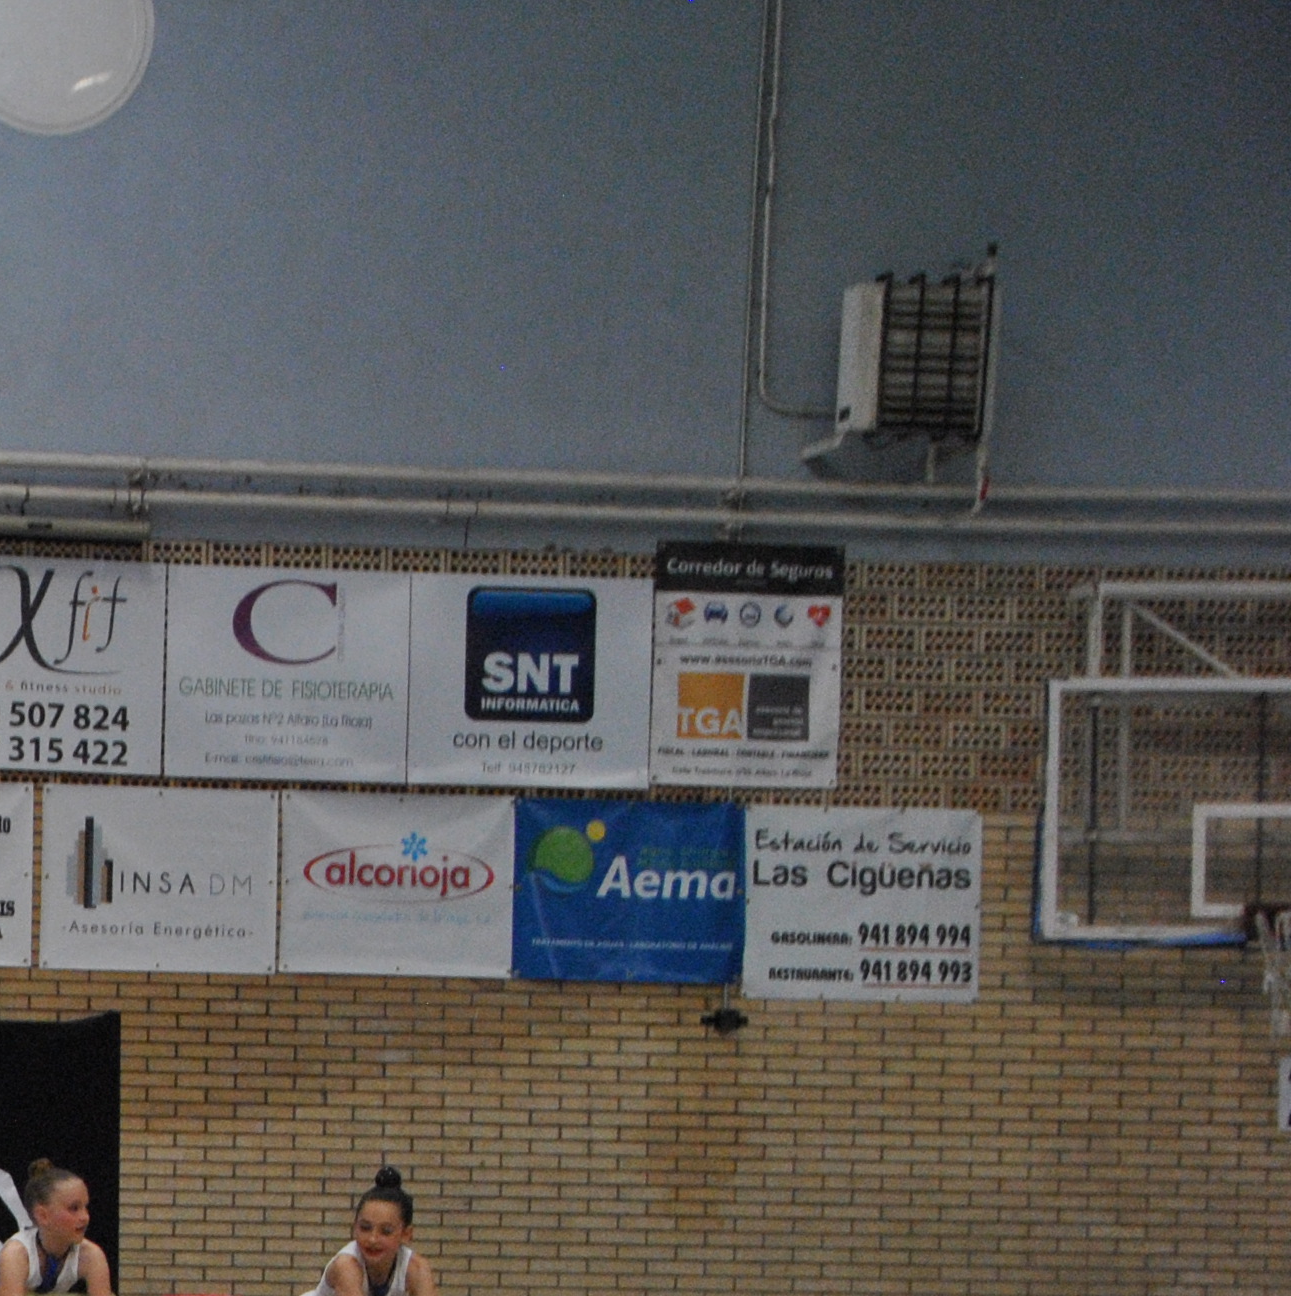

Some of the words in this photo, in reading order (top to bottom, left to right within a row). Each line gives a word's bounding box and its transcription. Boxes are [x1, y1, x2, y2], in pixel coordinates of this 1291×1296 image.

[666, 556, 741, 576] Corredor
[746, 558, 766, 576] de
[771, 559, 834, 583] Seguros
[232, 579, 338, 666] C
[481, 651, 580, 694] SNT
[4, 681, 15, 690] &
[20, 679, 69, 693] fitness
[74, 682, 123, 696] studio
[179, 676, 257, 698] GABINETE
[262, 679, 283, 697] DE
[291, 680, 394, 701] FISIOTERAPIA
[9, 701, 65, 728] 507
[73, 704, 130, 732] 824
[480, 697, 580, 714] INFORMATICA
[678, 707, 744, 737] TGA
[8, 736, 64, 763] 315
[72, 739, 128, 767] 422
[452, 731, 491, 750] con
[497, 730, 517, 750] el
[523, 731, 604, 755] deporte
[754, 828, 843, 853] Estación
[853, 832, 879, 855] de
[888, 831, 972, 856] Servicio
[119, 870, 195, 895] INSA
[208, 872, 254, 897] DM
[324, 851, 471, 898] alcorioja
[595, 854, 737, 900] Aema
[753, 859, 809, 888] Las
[826, 860, 972, 896] Cigüeñas
[858, 922, 890, 946] 941
[895, 923, 931, 947] 894
[936, 924, 972, 948] 994
[859, 958, 891, 983] 941
[896, 959, 932, 984] 894
[938, 960, 974, 985] 993
